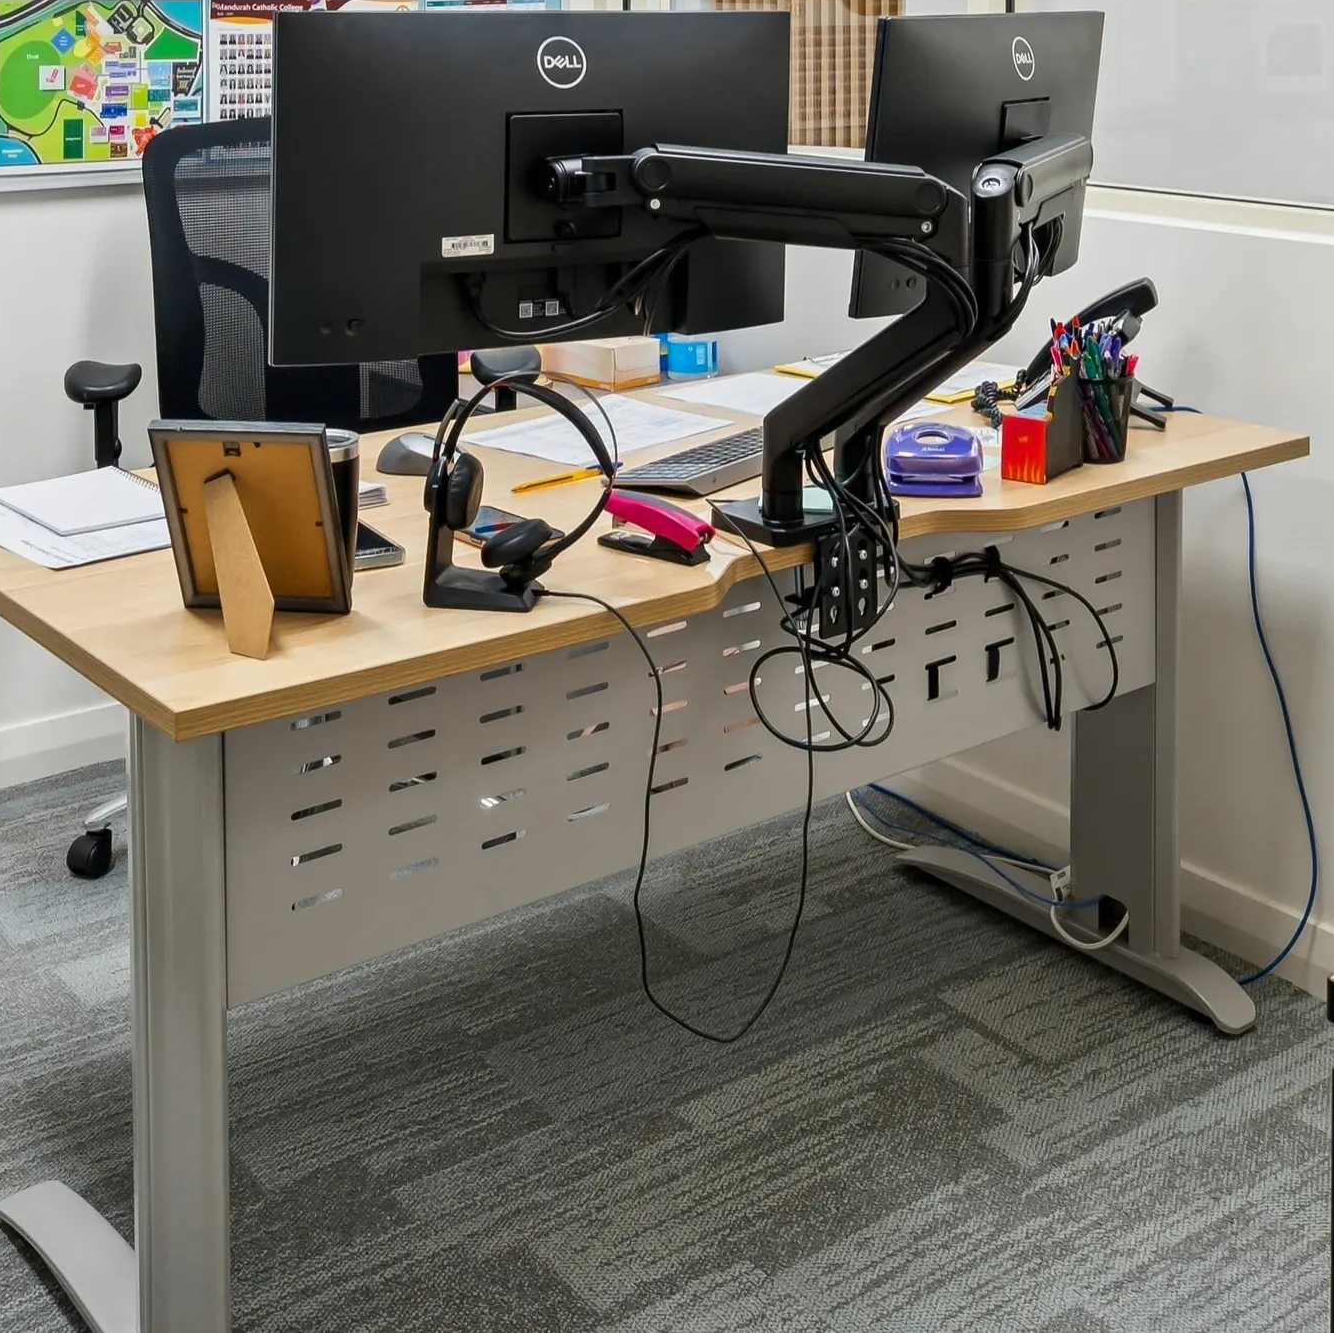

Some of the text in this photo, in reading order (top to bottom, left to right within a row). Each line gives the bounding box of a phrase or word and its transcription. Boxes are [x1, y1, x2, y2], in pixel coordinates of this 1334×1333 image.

[217, 3, 304, 12] Mandurah Catholic College
[543, 55, 582, 69] DELL
[1015, 52, 1033, 65] DELL
